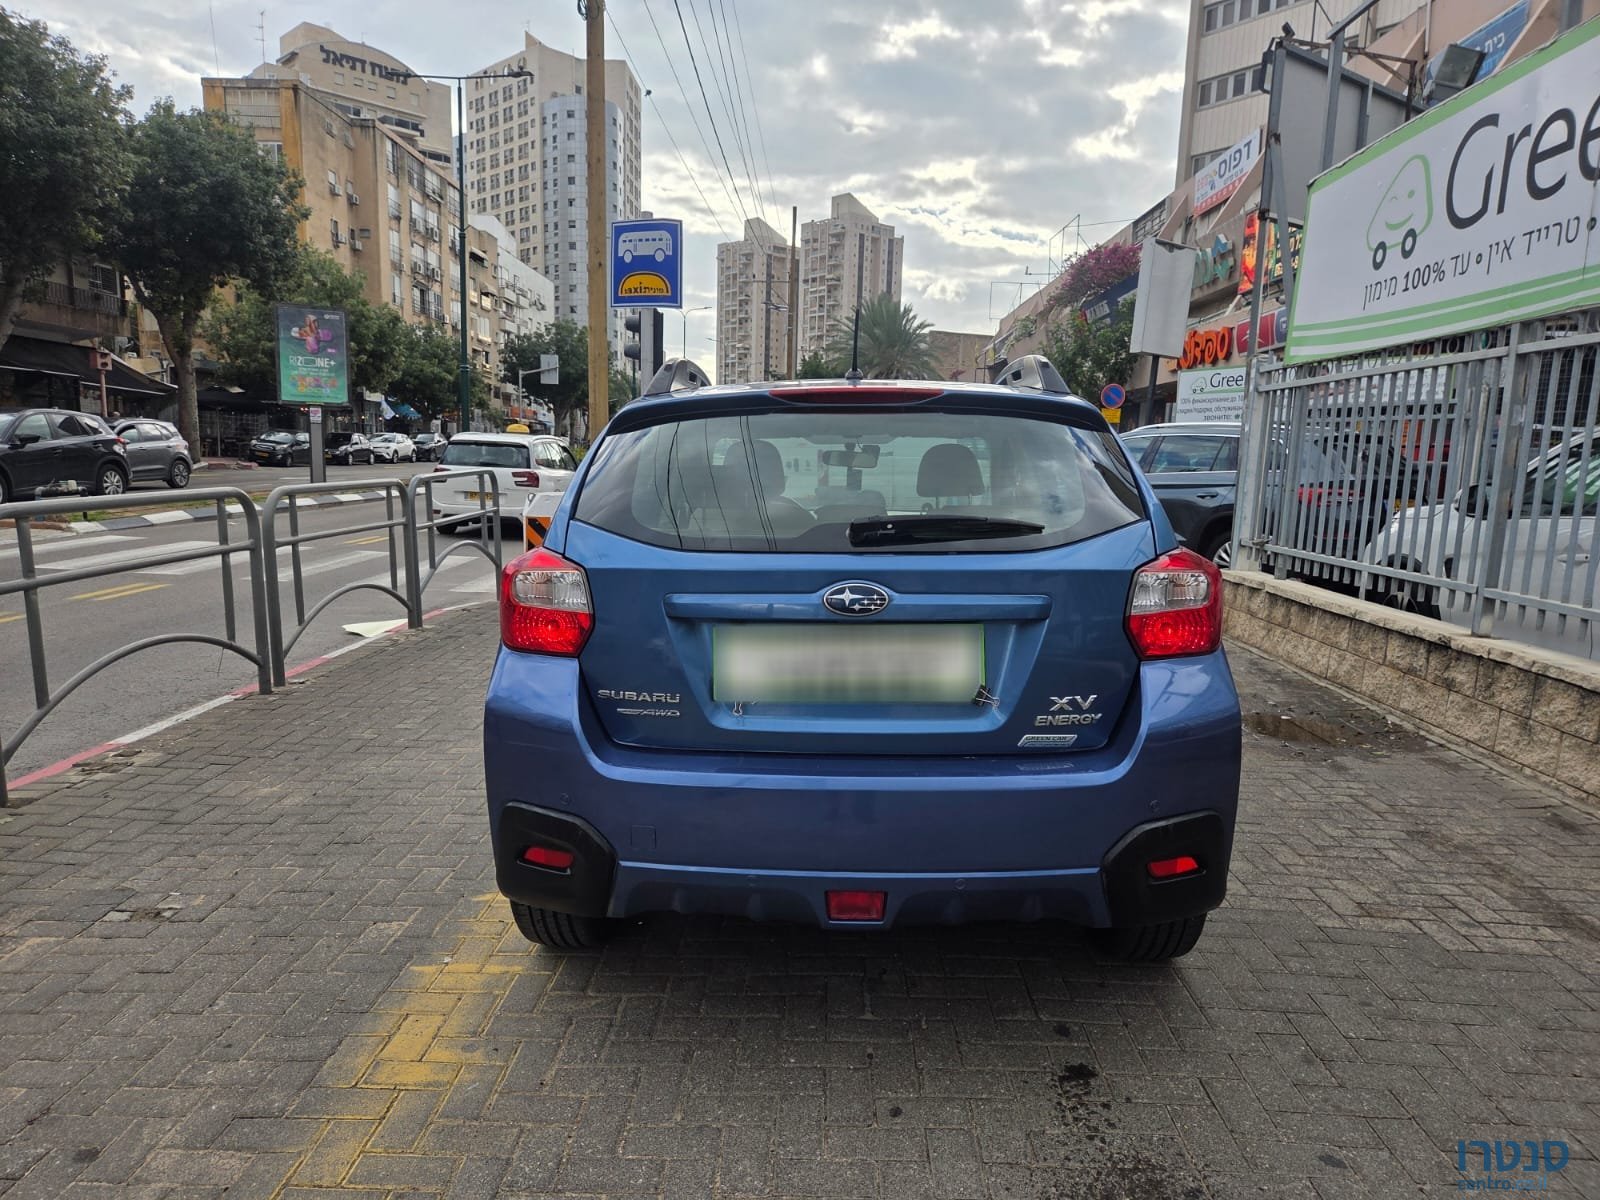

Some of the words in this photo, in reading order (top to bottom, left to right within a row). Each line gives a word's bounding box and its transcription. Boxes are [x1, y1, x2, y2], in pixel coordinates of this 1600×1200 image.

[319, 44, 368, 74] דניאל
[1218, 139, 1253, 180] דפוס
[1522, 216, 1581, 256] טרייד
[1450, 251, 1471, 278] עד
[1486, 236, 1516, 276] אין
[1402, 259, 1446, 293] 100%
[1362, 276, 1398, 310] מימון
[597, 689, 681, 703] SUBARU
[1049, 694, 1098, 711] XV
[1034, 713, 1103, 727] ENERGY
